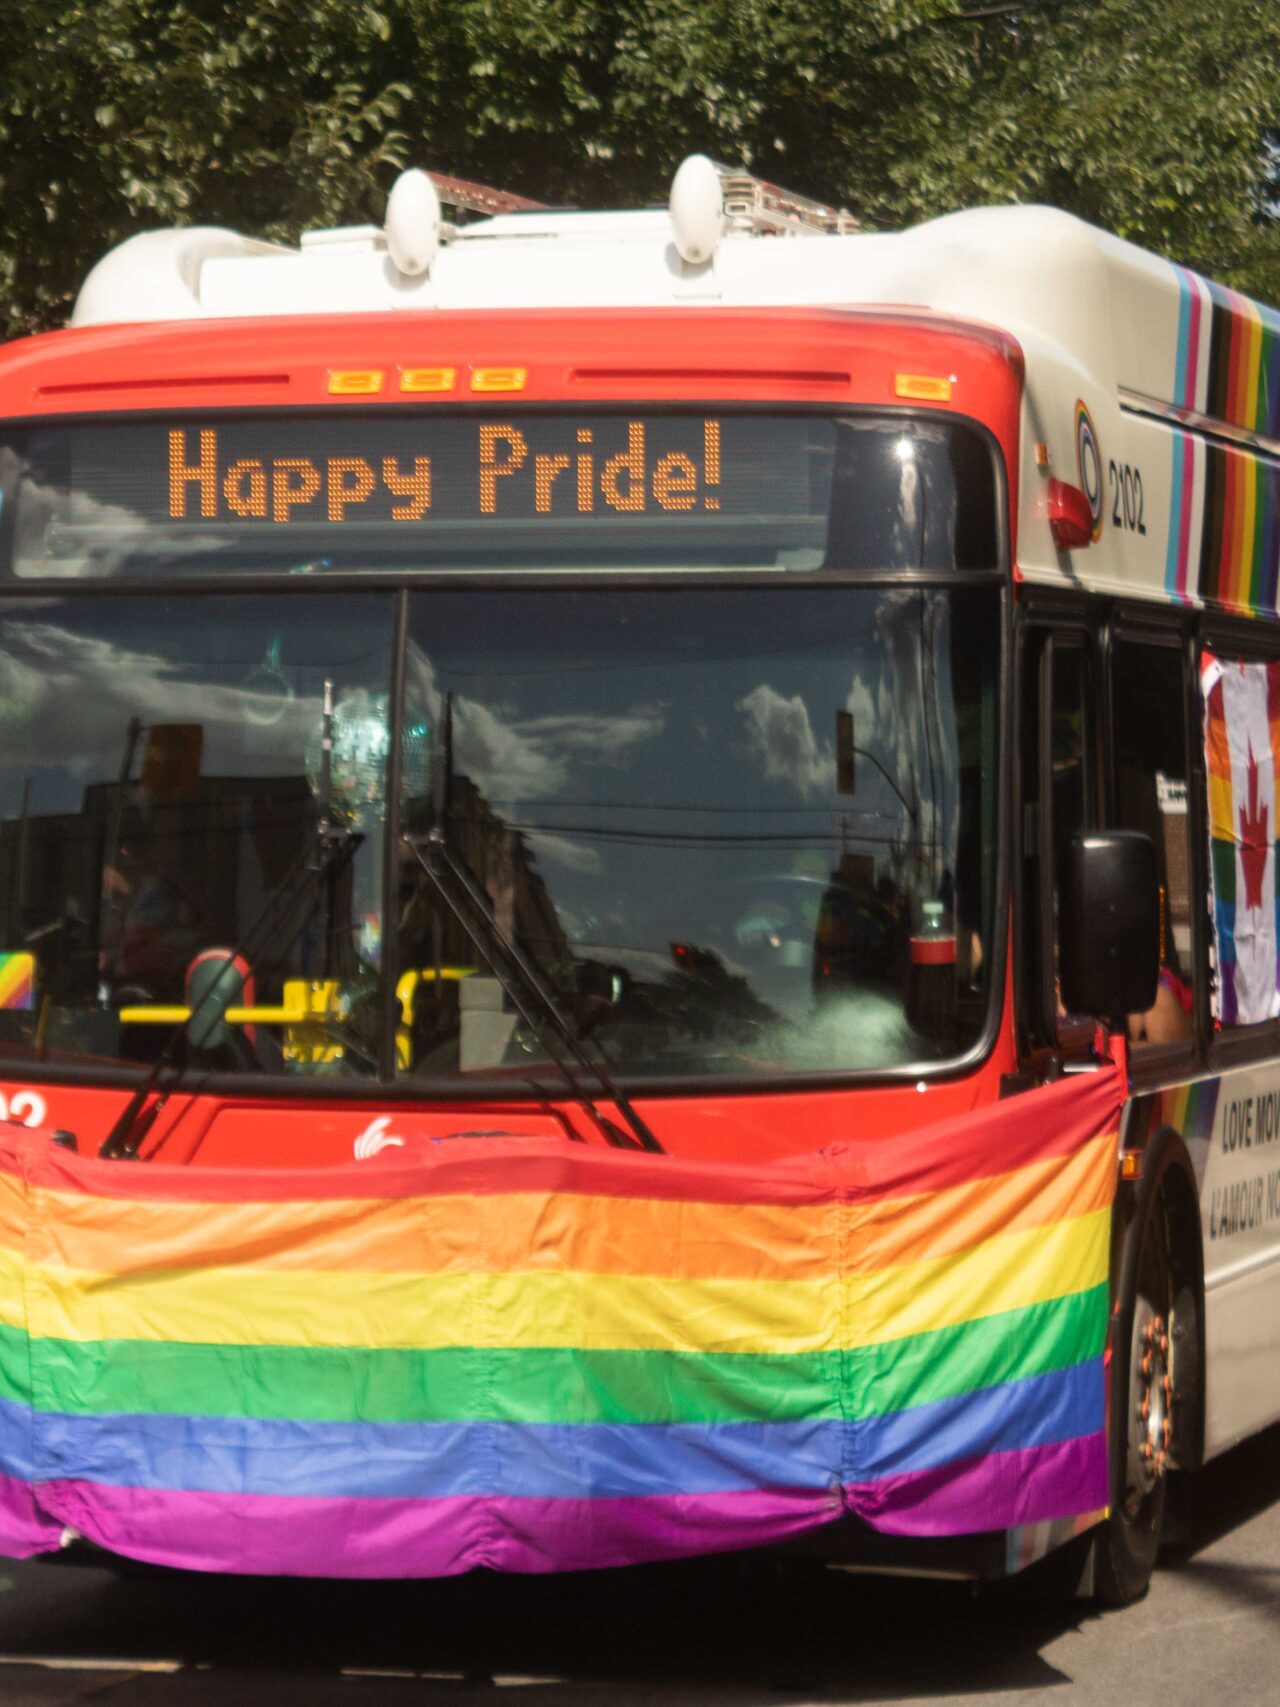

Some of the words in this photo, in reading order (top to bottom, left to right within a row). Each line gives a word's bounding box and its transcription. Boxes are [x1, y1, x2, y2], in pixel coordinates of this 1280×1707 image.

[168, 429, 432, 522] Happy
[478, 419, 720, 513] Pride!
[1108, 458, 1146, 537] 2102
[1222, 1098, 1253, 1153] LOVE
[1210, 1177, 1264, 1240] L'AMOUR
